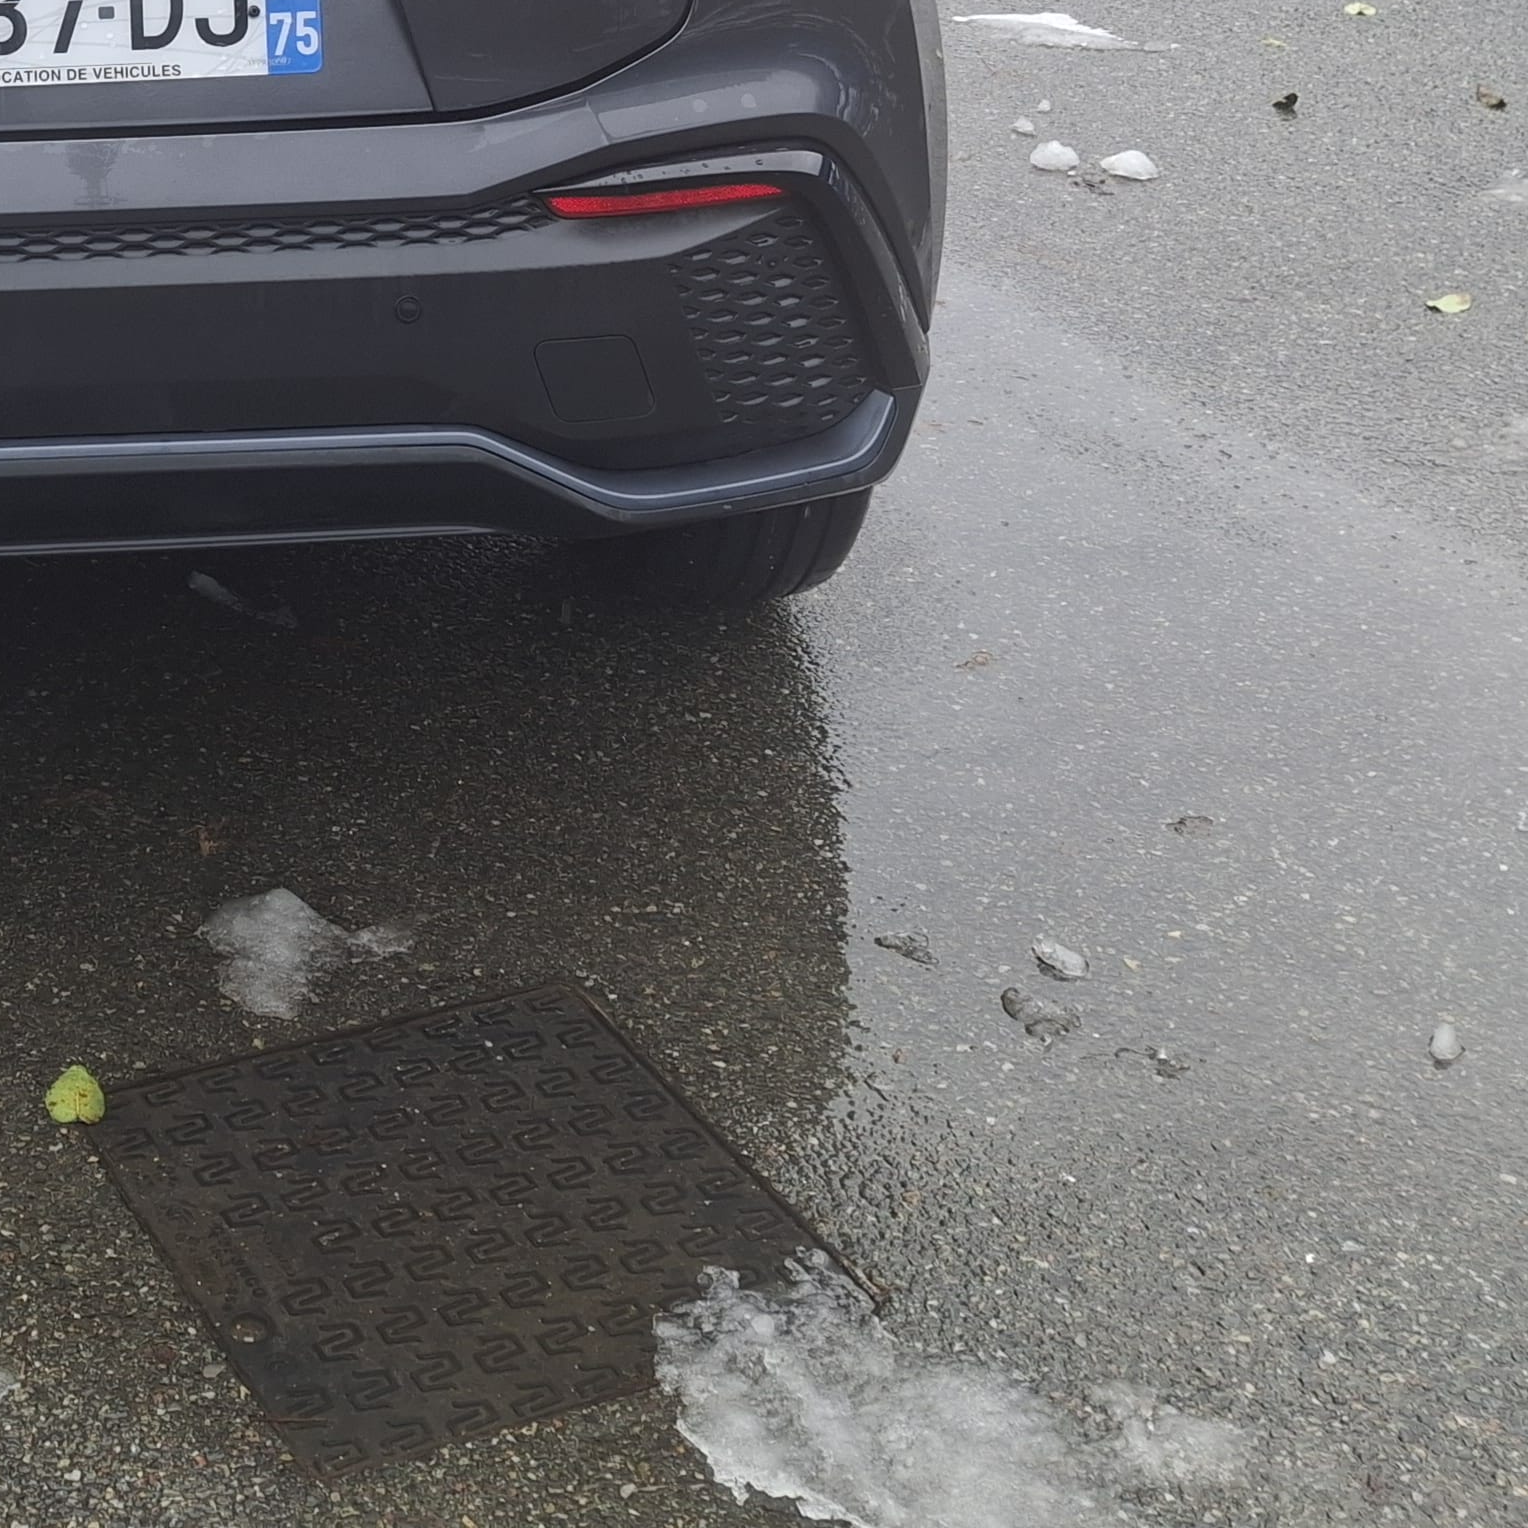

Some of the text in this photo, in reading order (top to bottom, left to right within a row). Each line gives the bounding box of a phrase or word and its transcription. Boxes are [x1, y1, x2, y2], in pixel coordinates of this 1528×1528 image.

[269, 10, 319, 56] 75
[67, 64, 88, 81] DE
[93, 64, 182, 80] VEHICULES
